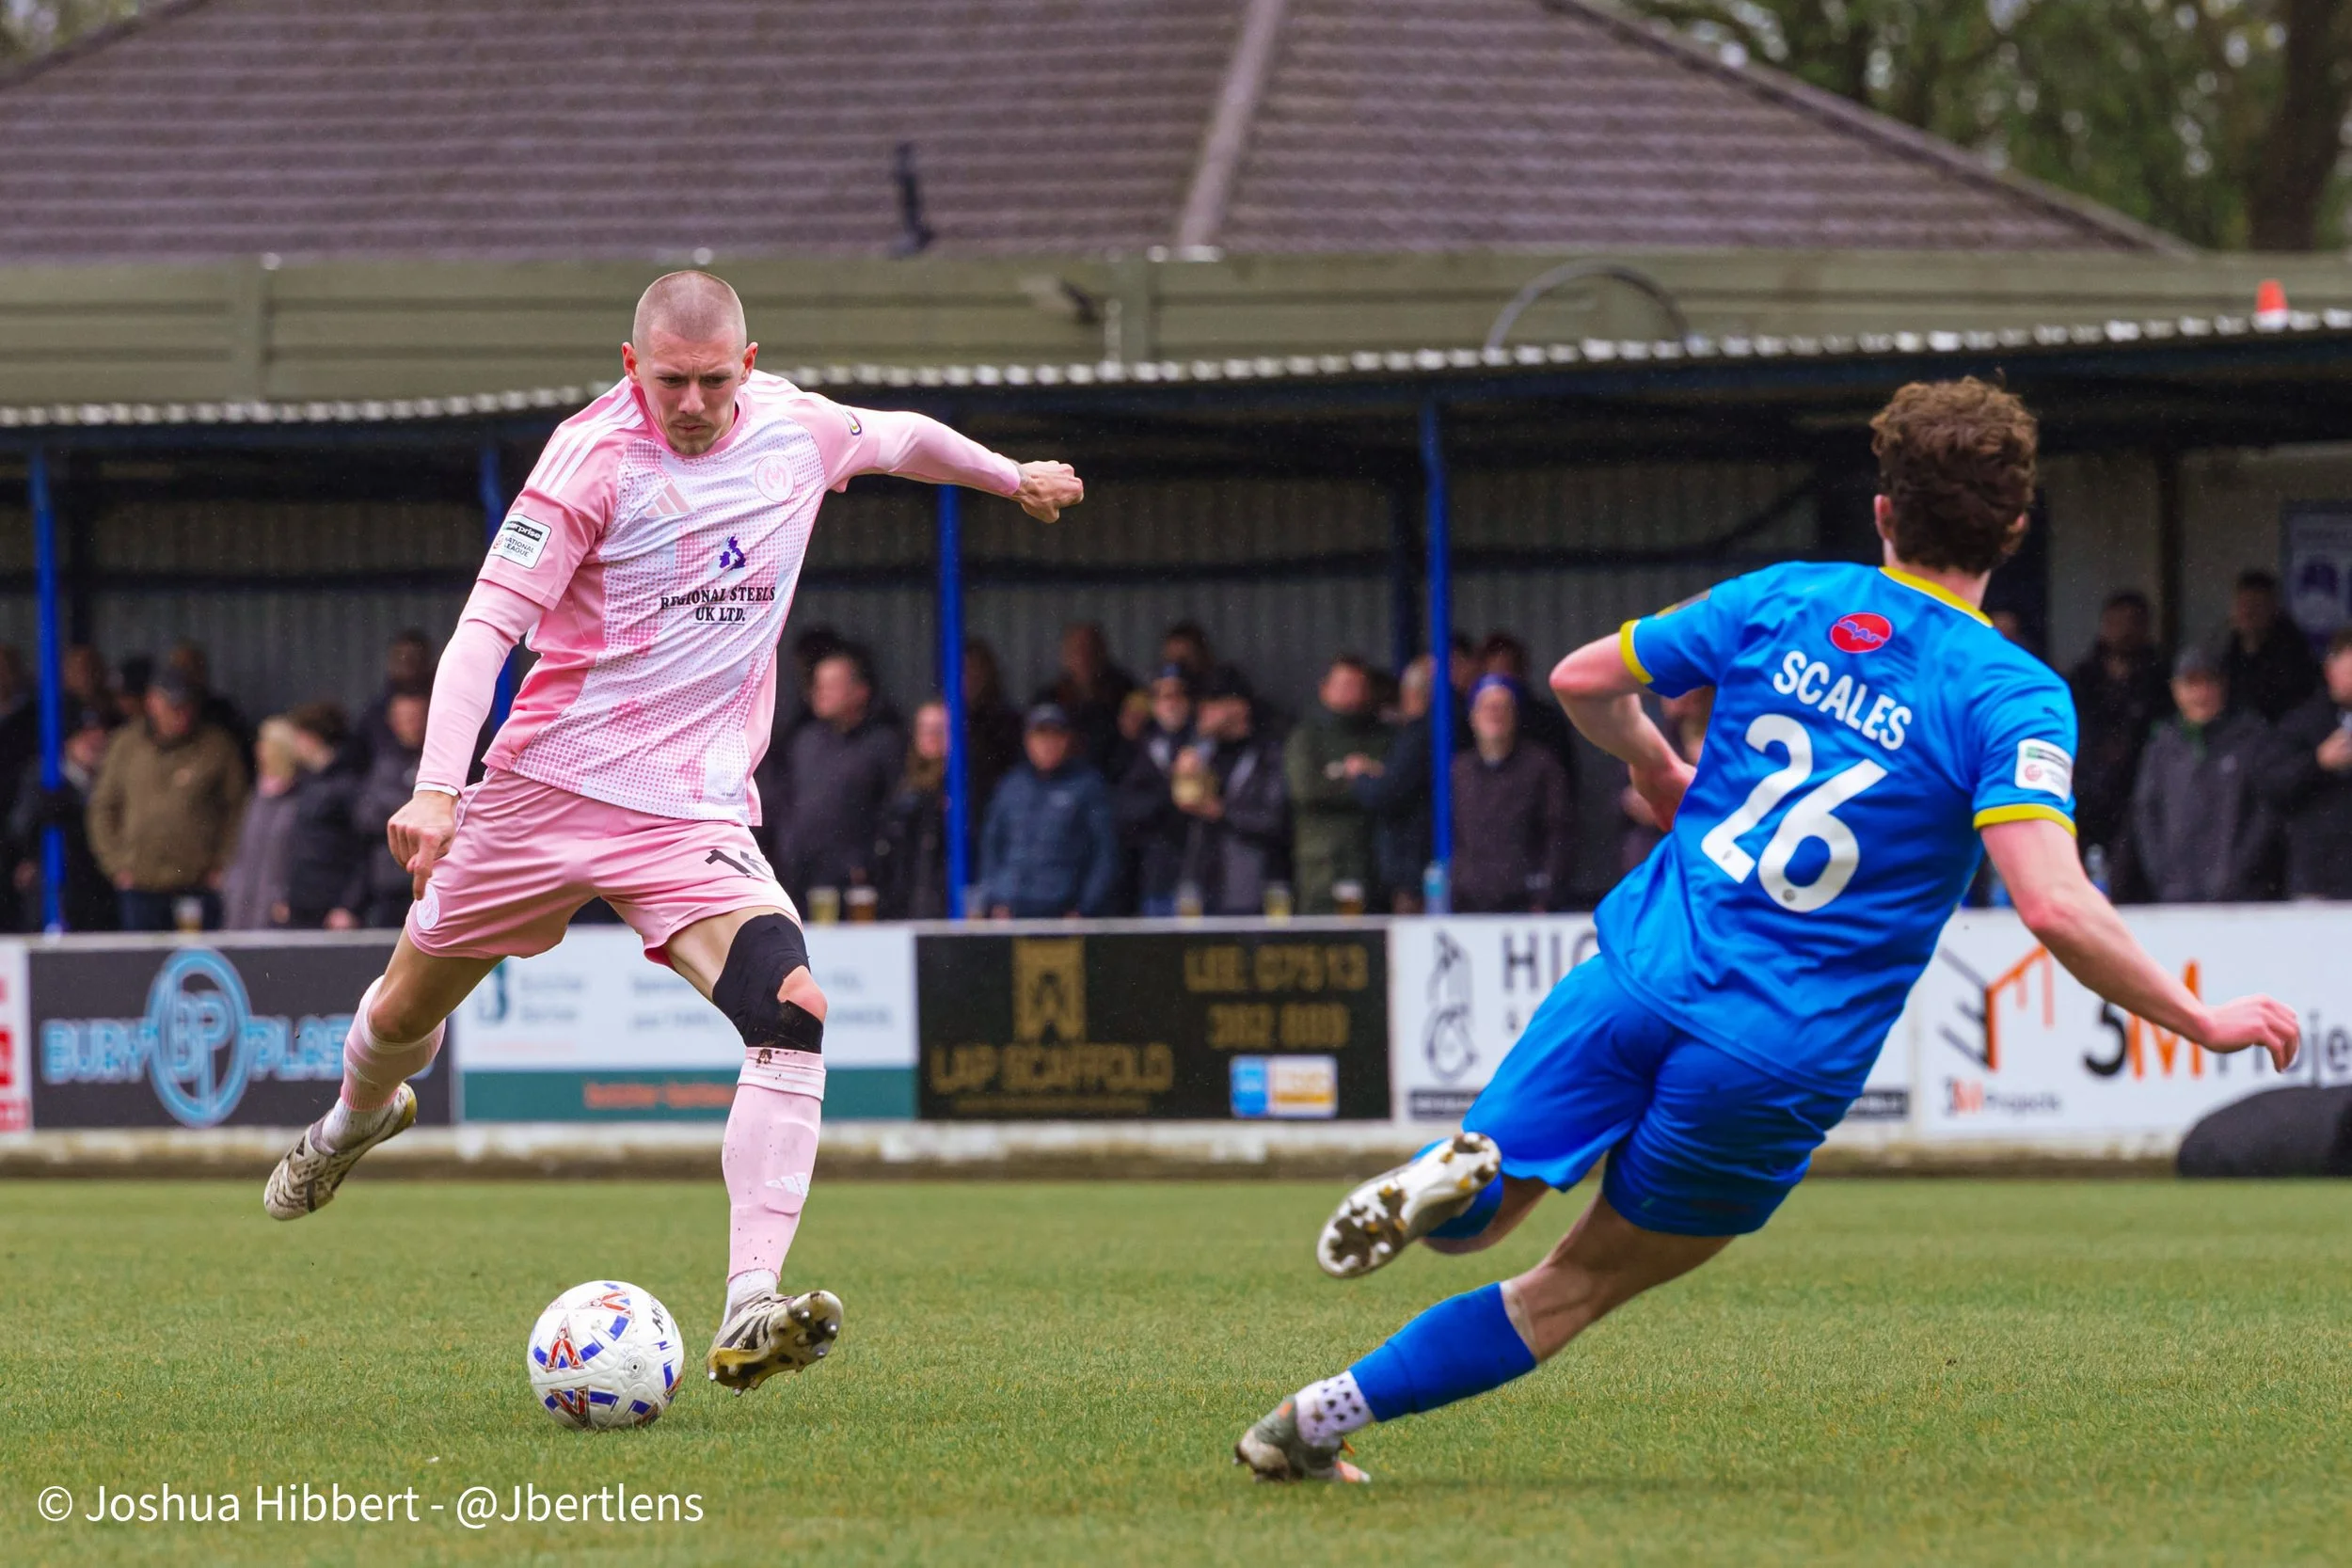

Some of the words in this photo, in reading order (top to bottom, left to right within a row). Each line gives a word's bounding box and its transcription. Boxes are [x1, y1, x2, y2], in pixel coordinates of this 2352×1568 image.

[660, 589, 725, 610] REGIONAL
[729, 586, 776, 601] STEELS
[695, 607, 715, 622] UK
[720, 608, 746, 623] LTD.
[1772, 651, 1912, 751] SCALES
[1701, 714, 1888, 912] 26
[44, 1021, 154, 1081] BURY
